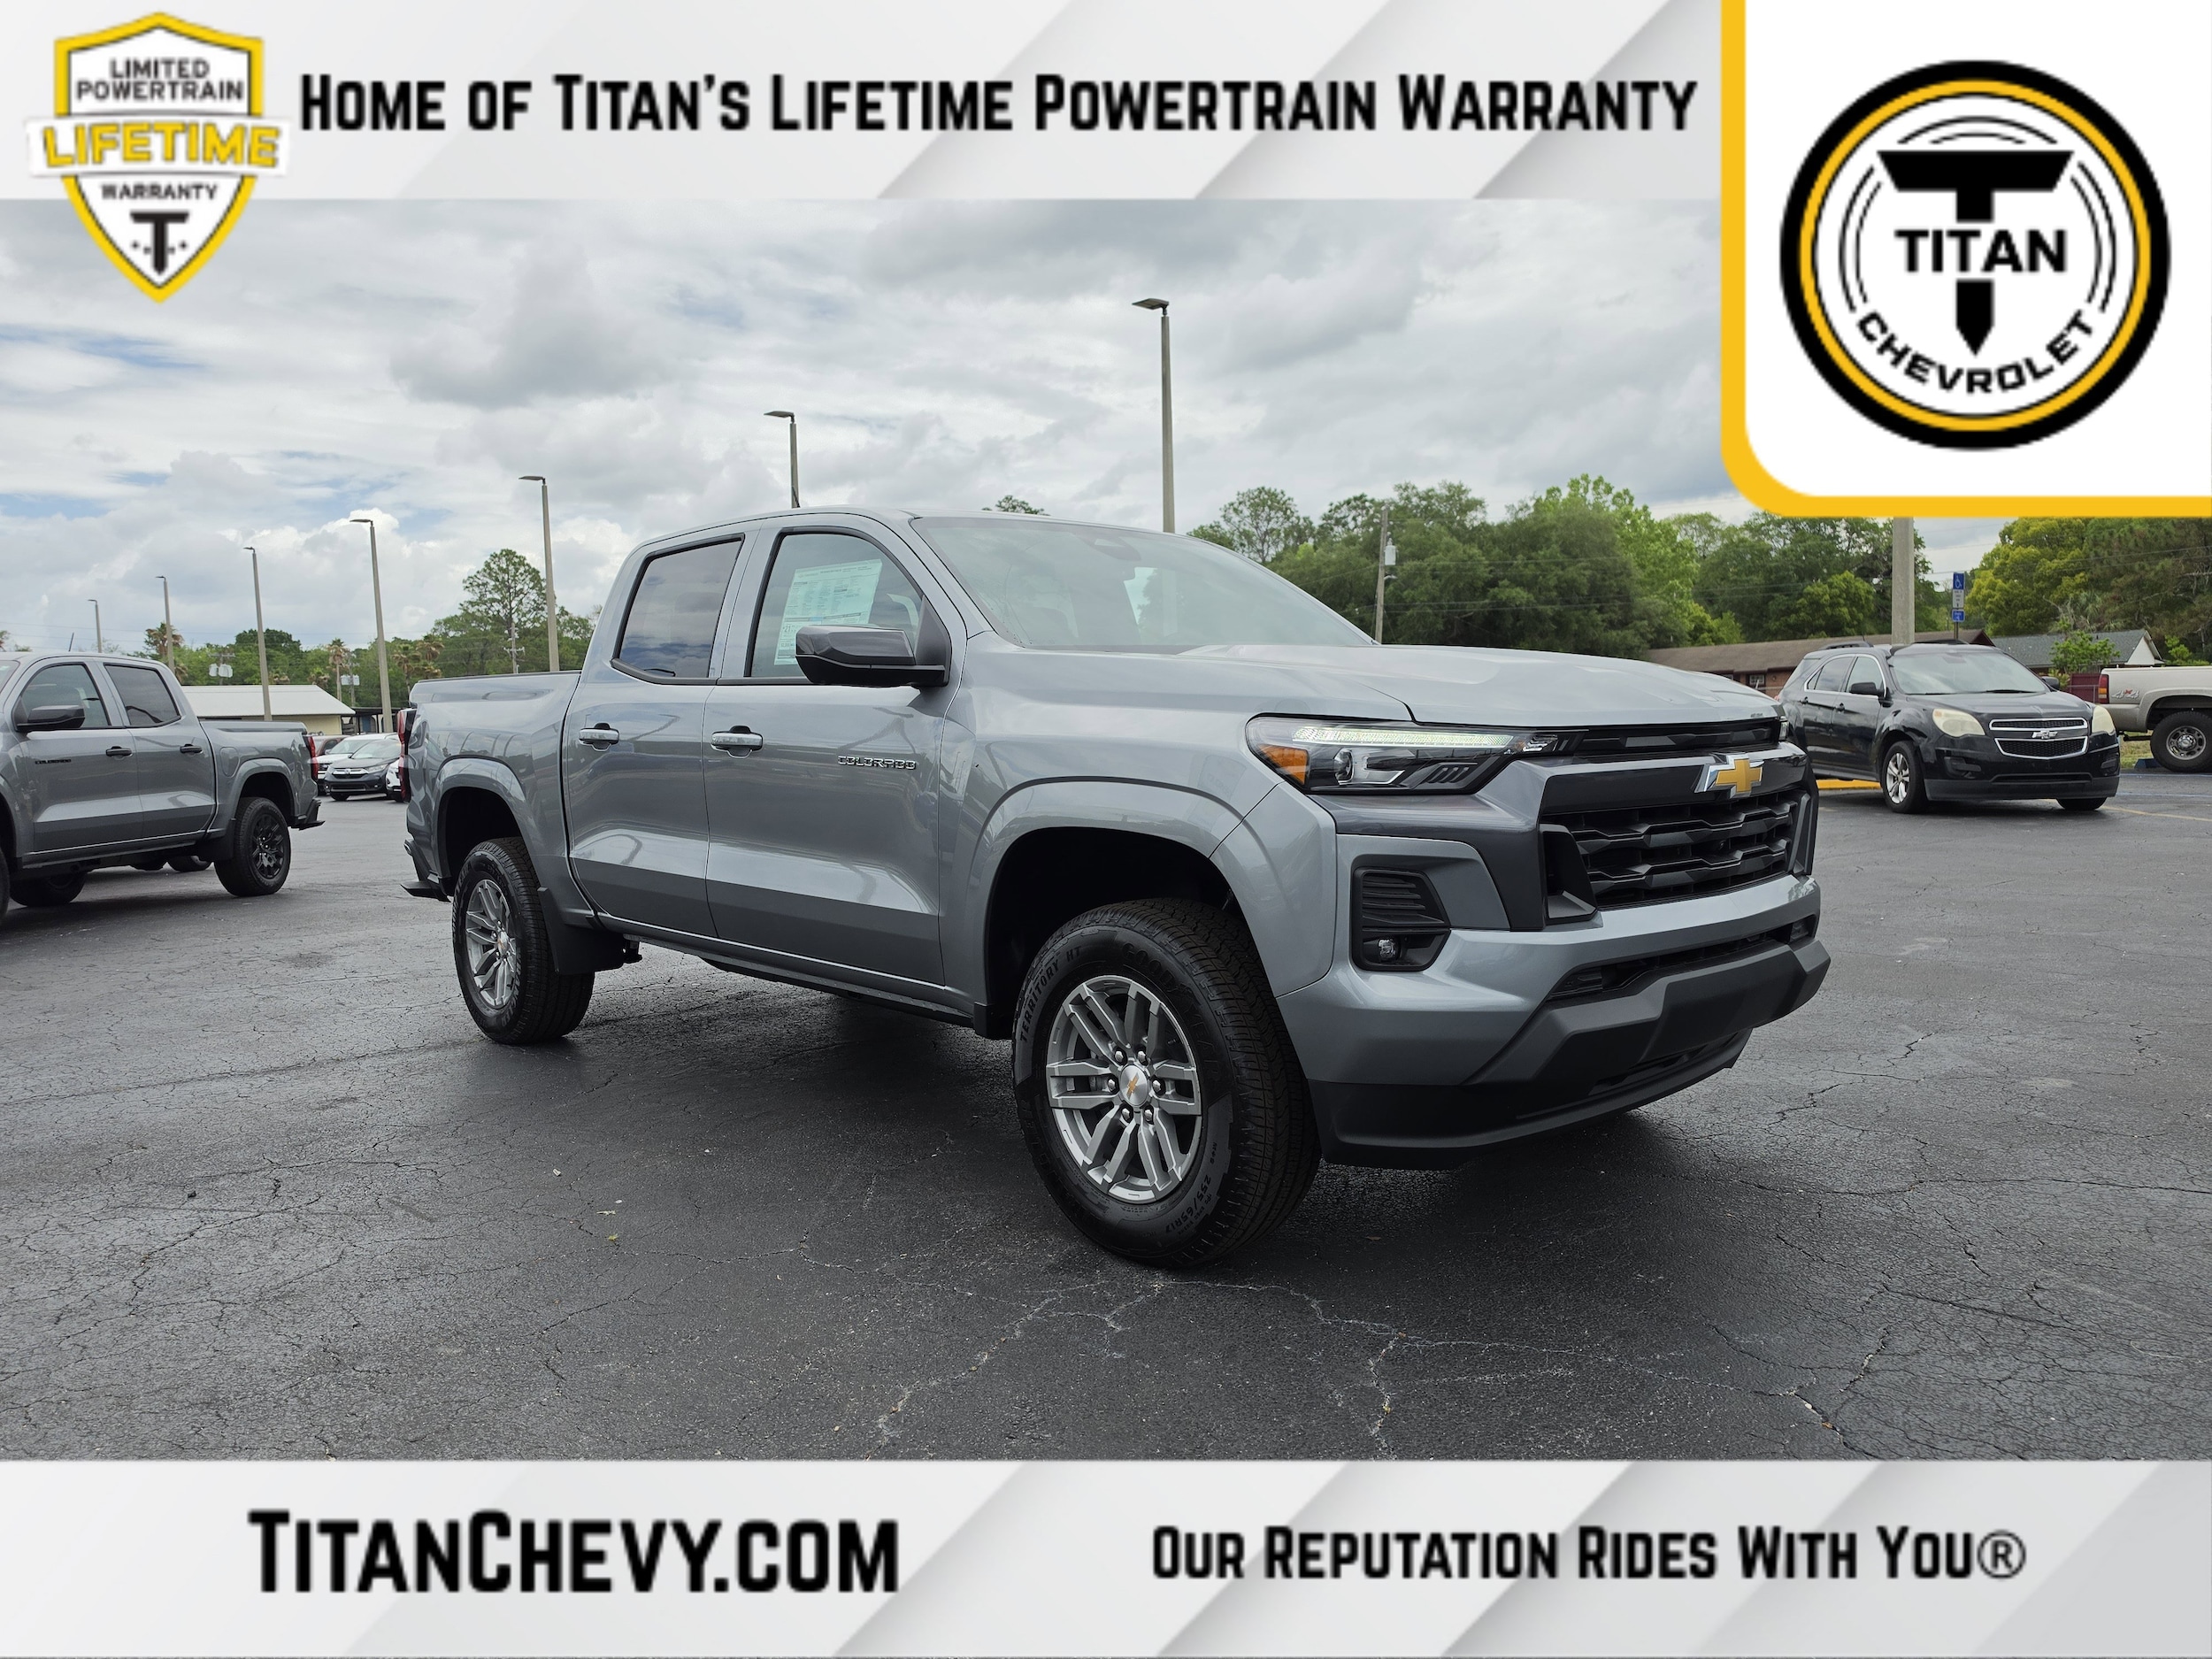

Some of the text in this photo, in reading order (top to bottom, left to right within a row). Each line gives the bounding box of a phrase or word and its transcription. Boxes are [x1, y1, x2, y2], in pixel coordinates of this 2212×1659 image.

[837, 755, 917, 771] COLORADO
[1019, 945, 1082, 1042] TERRITORY HT
[1164, 1174, 1212, 1234] 255/65R17
